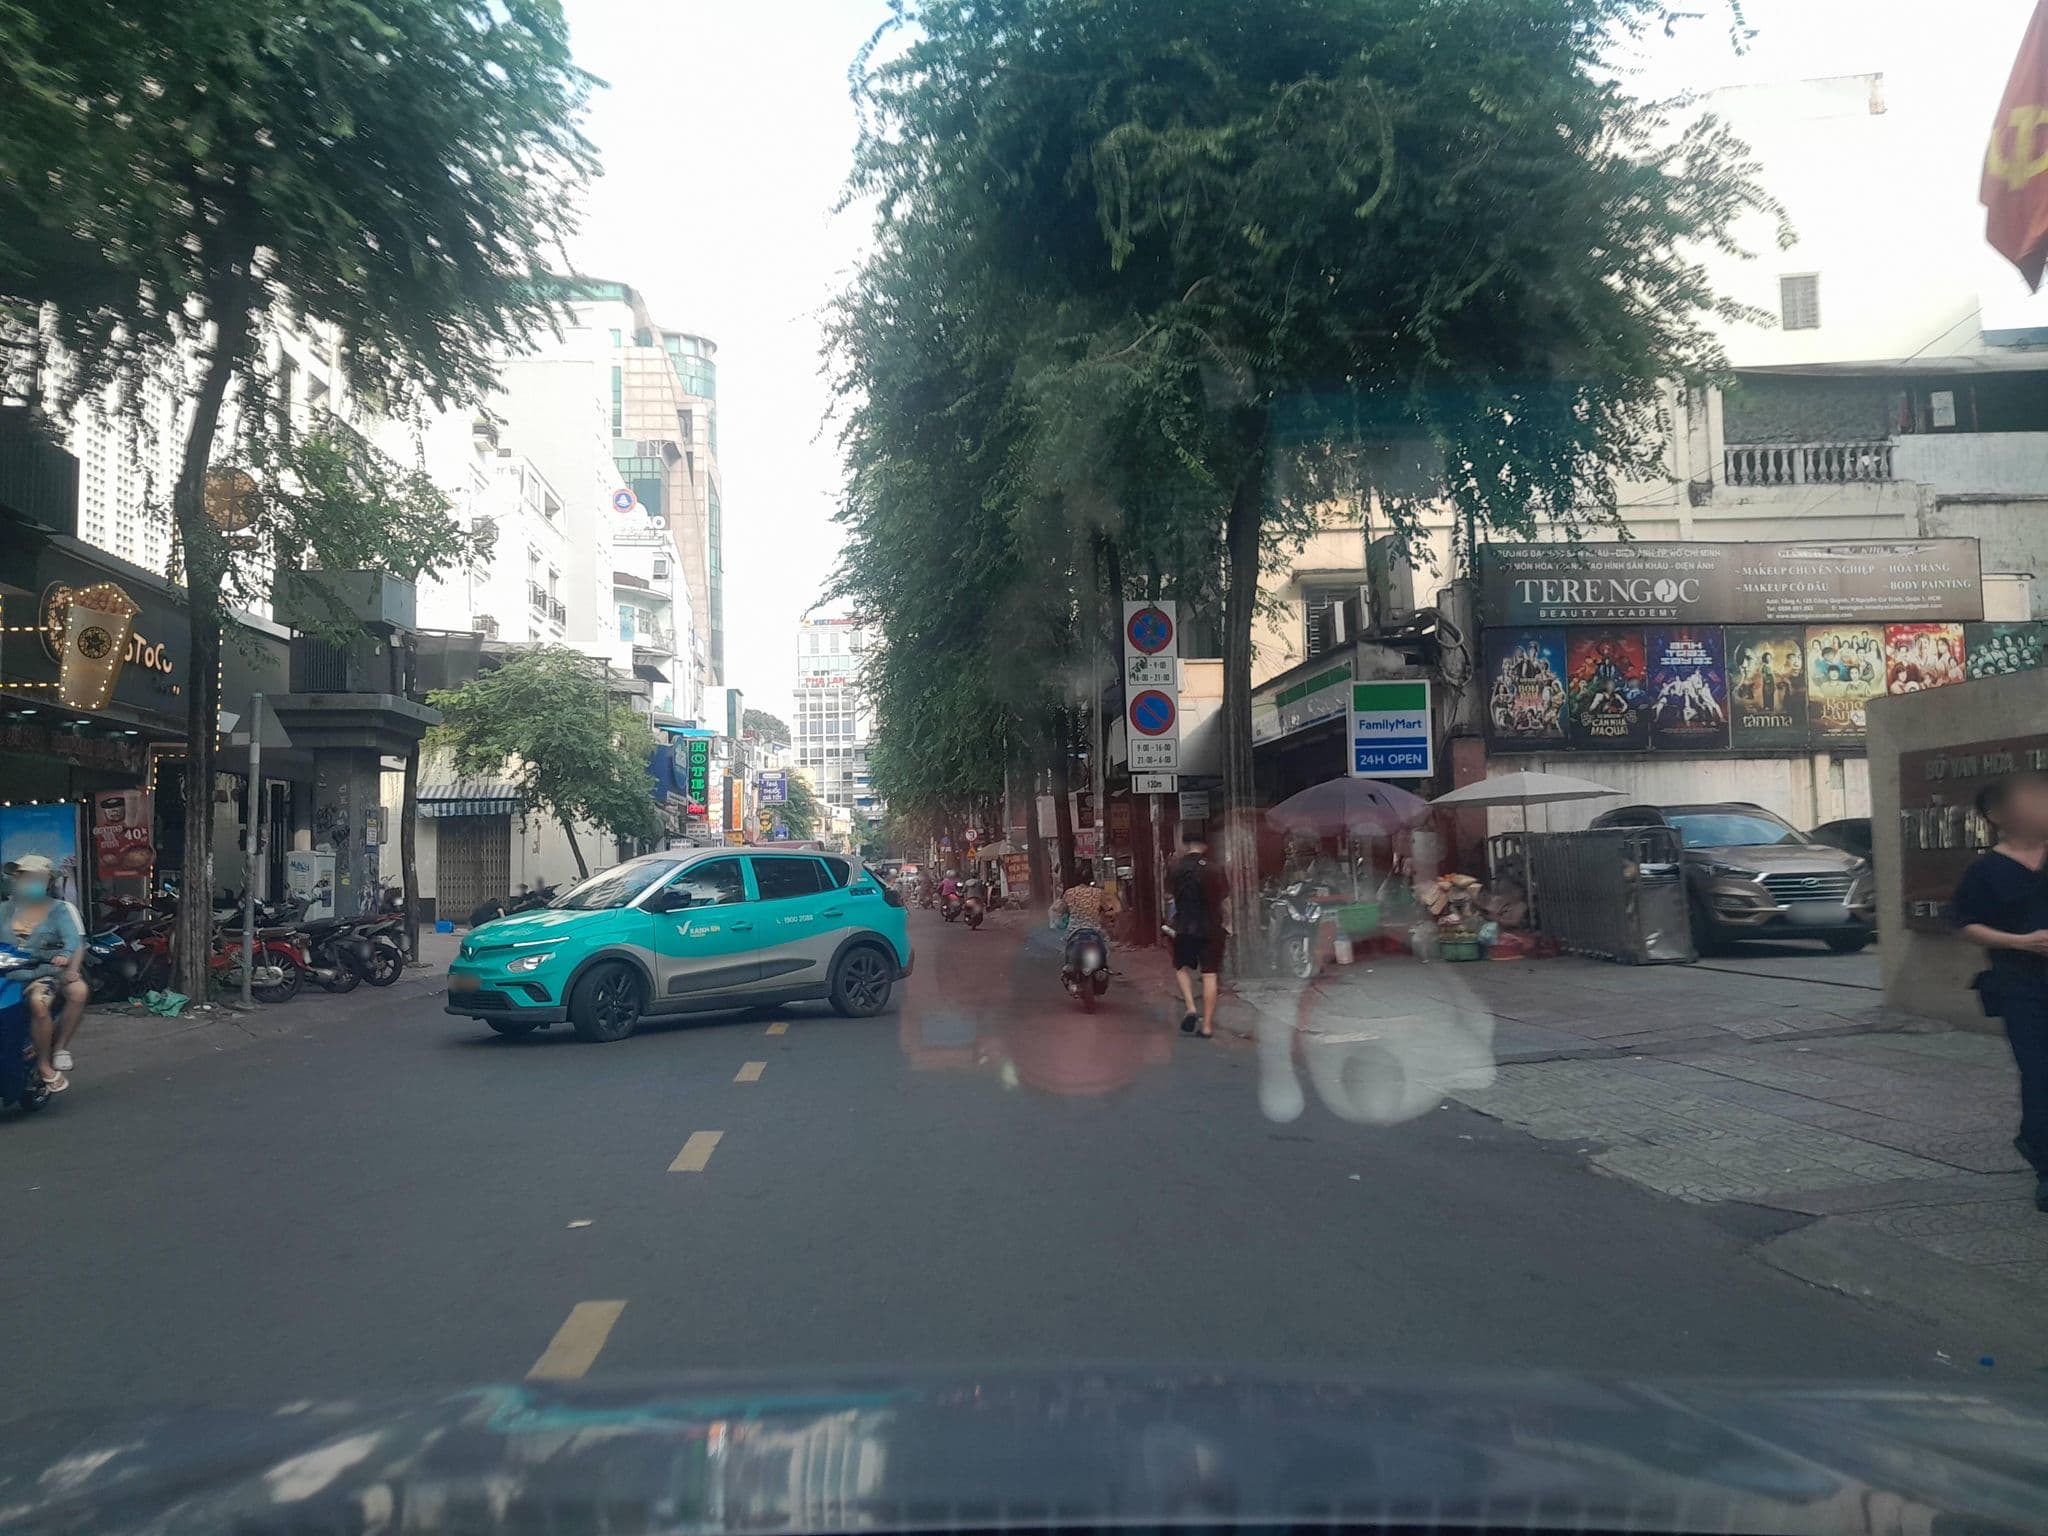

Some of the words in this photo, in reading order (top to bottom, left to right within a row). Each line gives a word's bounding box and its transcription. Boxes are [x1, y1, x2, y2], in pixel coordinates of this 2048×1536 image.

[1742, 582, 1789, 593] MAKEUP
[1890, 581, 1920, 590] BODY
[1921, 580, 1972, 590] PAINTING
[1539, 608, 1597, 618] BEAUTY
[1607, 607, 1678, 618] ACADEMY
[1359, 719, 1423, 732] FamilyMart
[1360, 754, 1385, 766] 24H
[1387, 753, 1422, 765] OPEN
[691, 741, 706, 803] HOTEL
